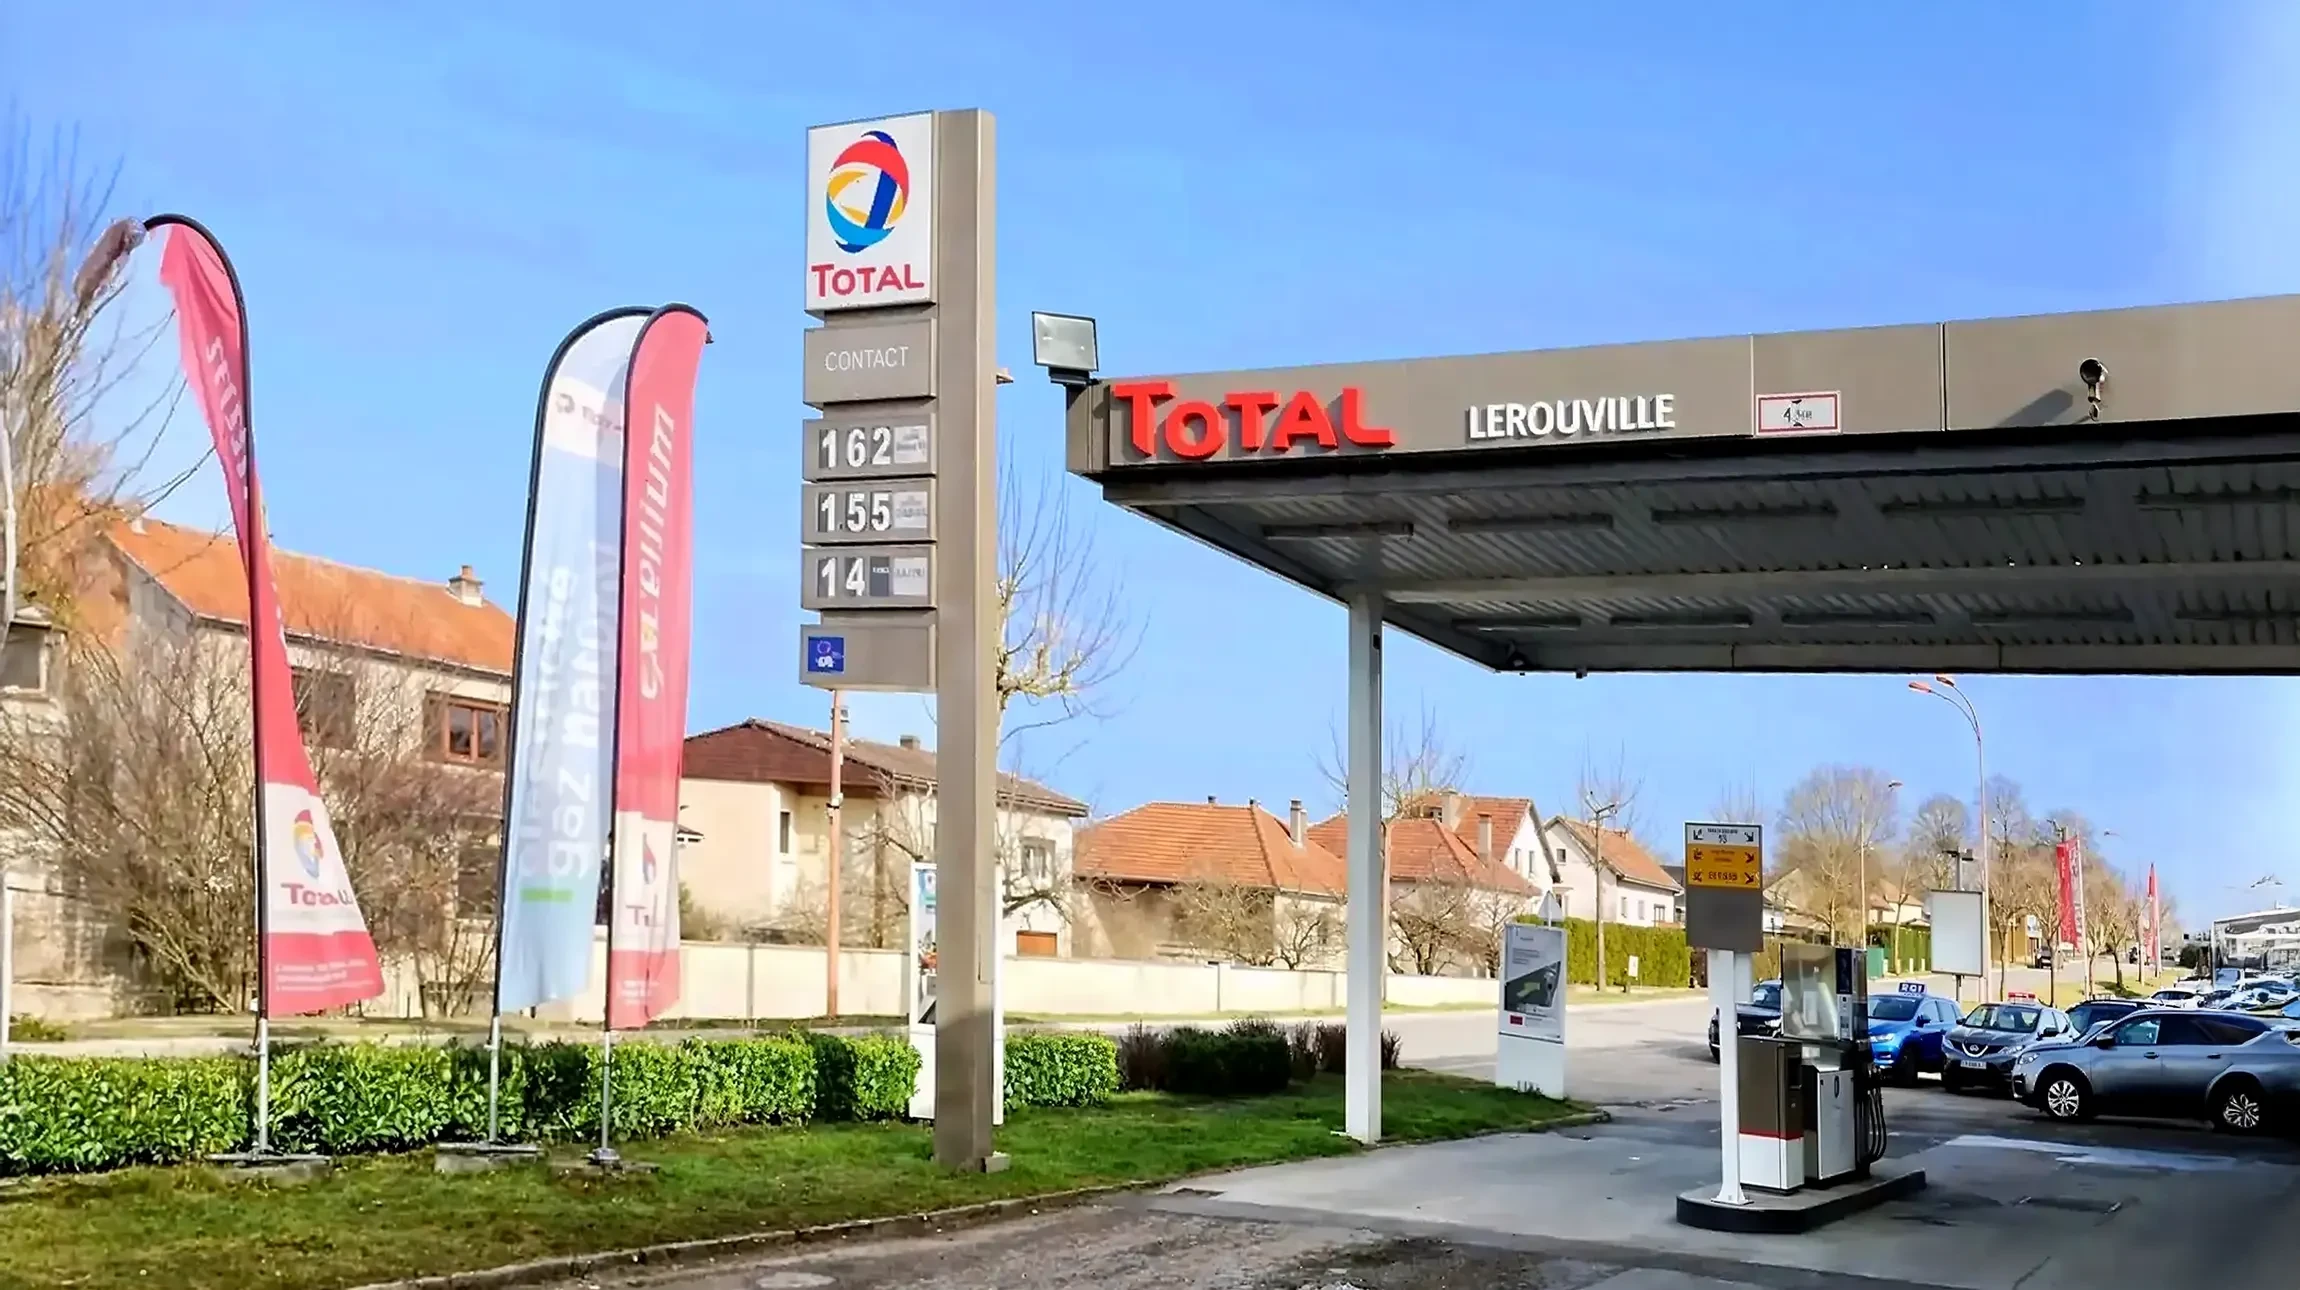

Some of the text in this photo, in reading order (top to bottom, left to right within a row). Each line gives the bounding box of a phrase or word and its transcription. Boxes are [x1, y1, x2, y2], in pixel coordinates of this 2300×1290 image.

[811, 264, 925, 298] TOTAL
[825, 346, 909, 372] CONTACT
[1113, 381, 1395, 460] TOTAL
[1469, 393, 1676, 440] LEROUVILLE
[548, 767, 596, 880] gaz
